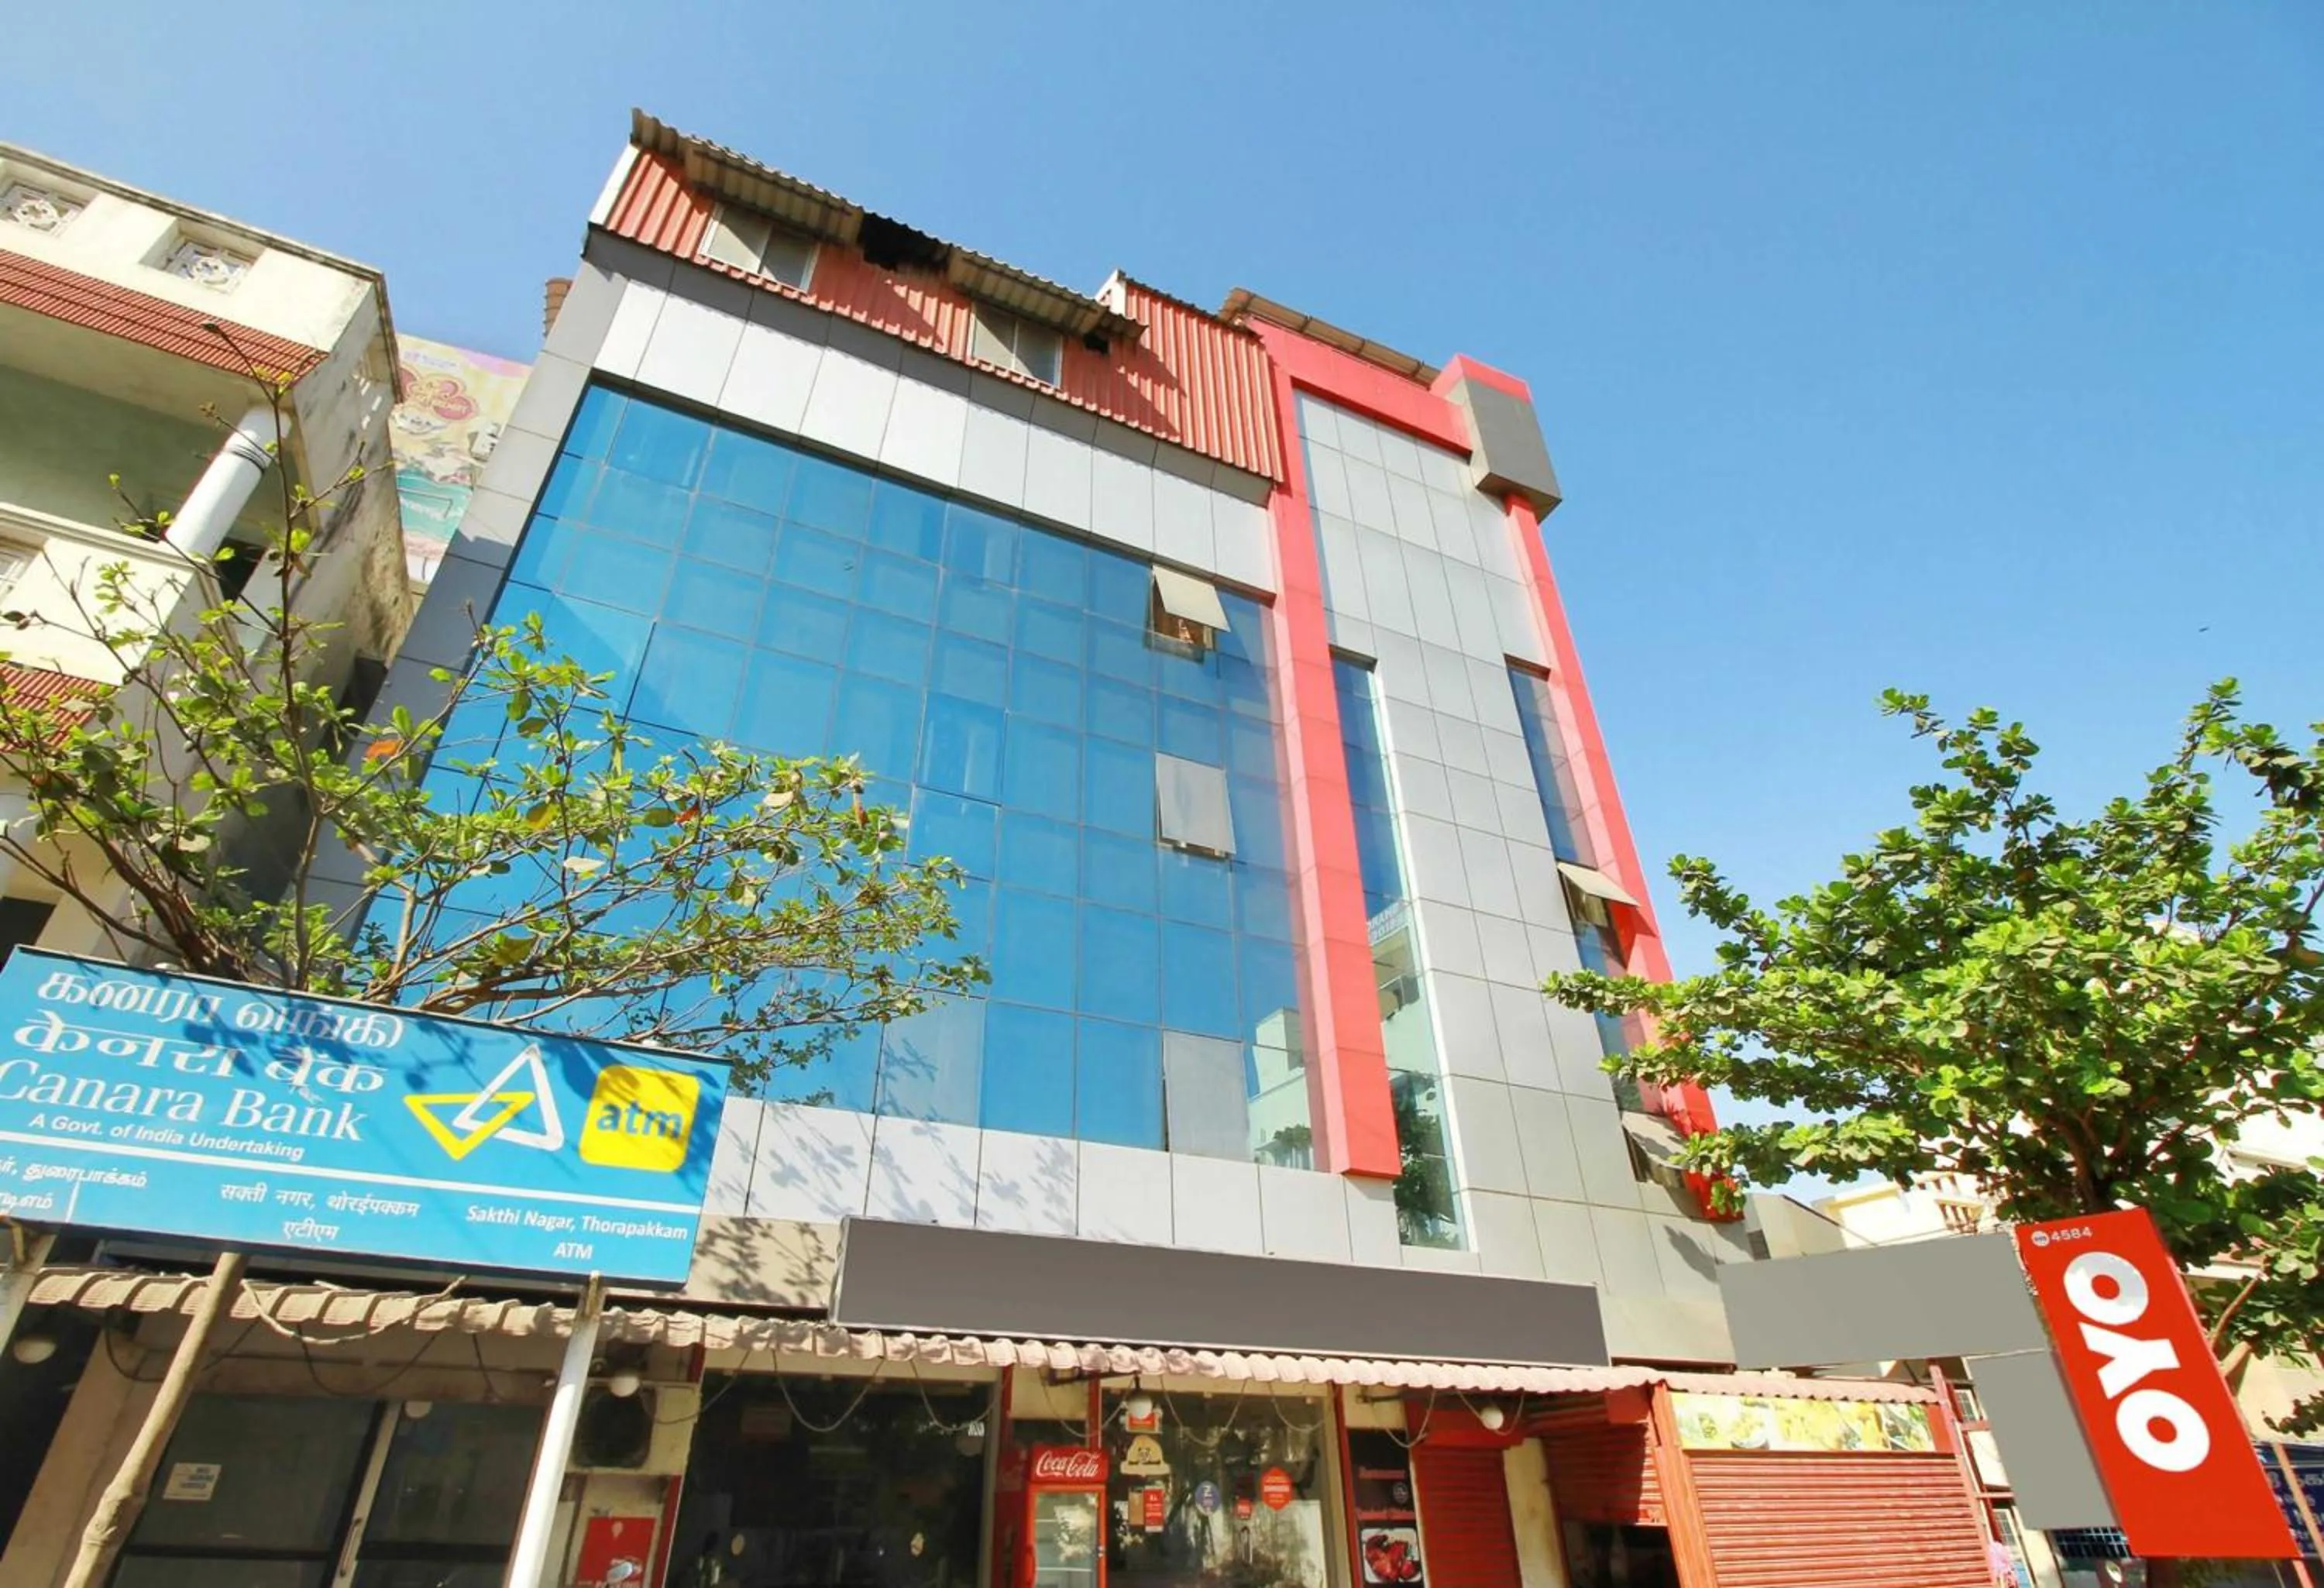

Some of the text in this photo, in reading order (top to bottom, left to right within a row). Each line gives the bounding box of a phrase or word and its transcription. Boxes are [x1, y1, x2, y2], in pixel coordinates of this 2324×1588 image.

[13, 1009, 389, 1093] केनरा बैंक
[0, 1060, 368, 1141] Canara Bank
[596, 1099, 682, 1139] atm
[29, 1113, 304, 1160] A Govt. of India Undertaking
[467, 1205, 688, 1240] Sakthi Nagar, Thorapakkam
[2051, 1226, 2092, 1242] 4584
[554, 1243, 593, 1260] ATM
[2064, 1252, 2210, 1473] OYO
